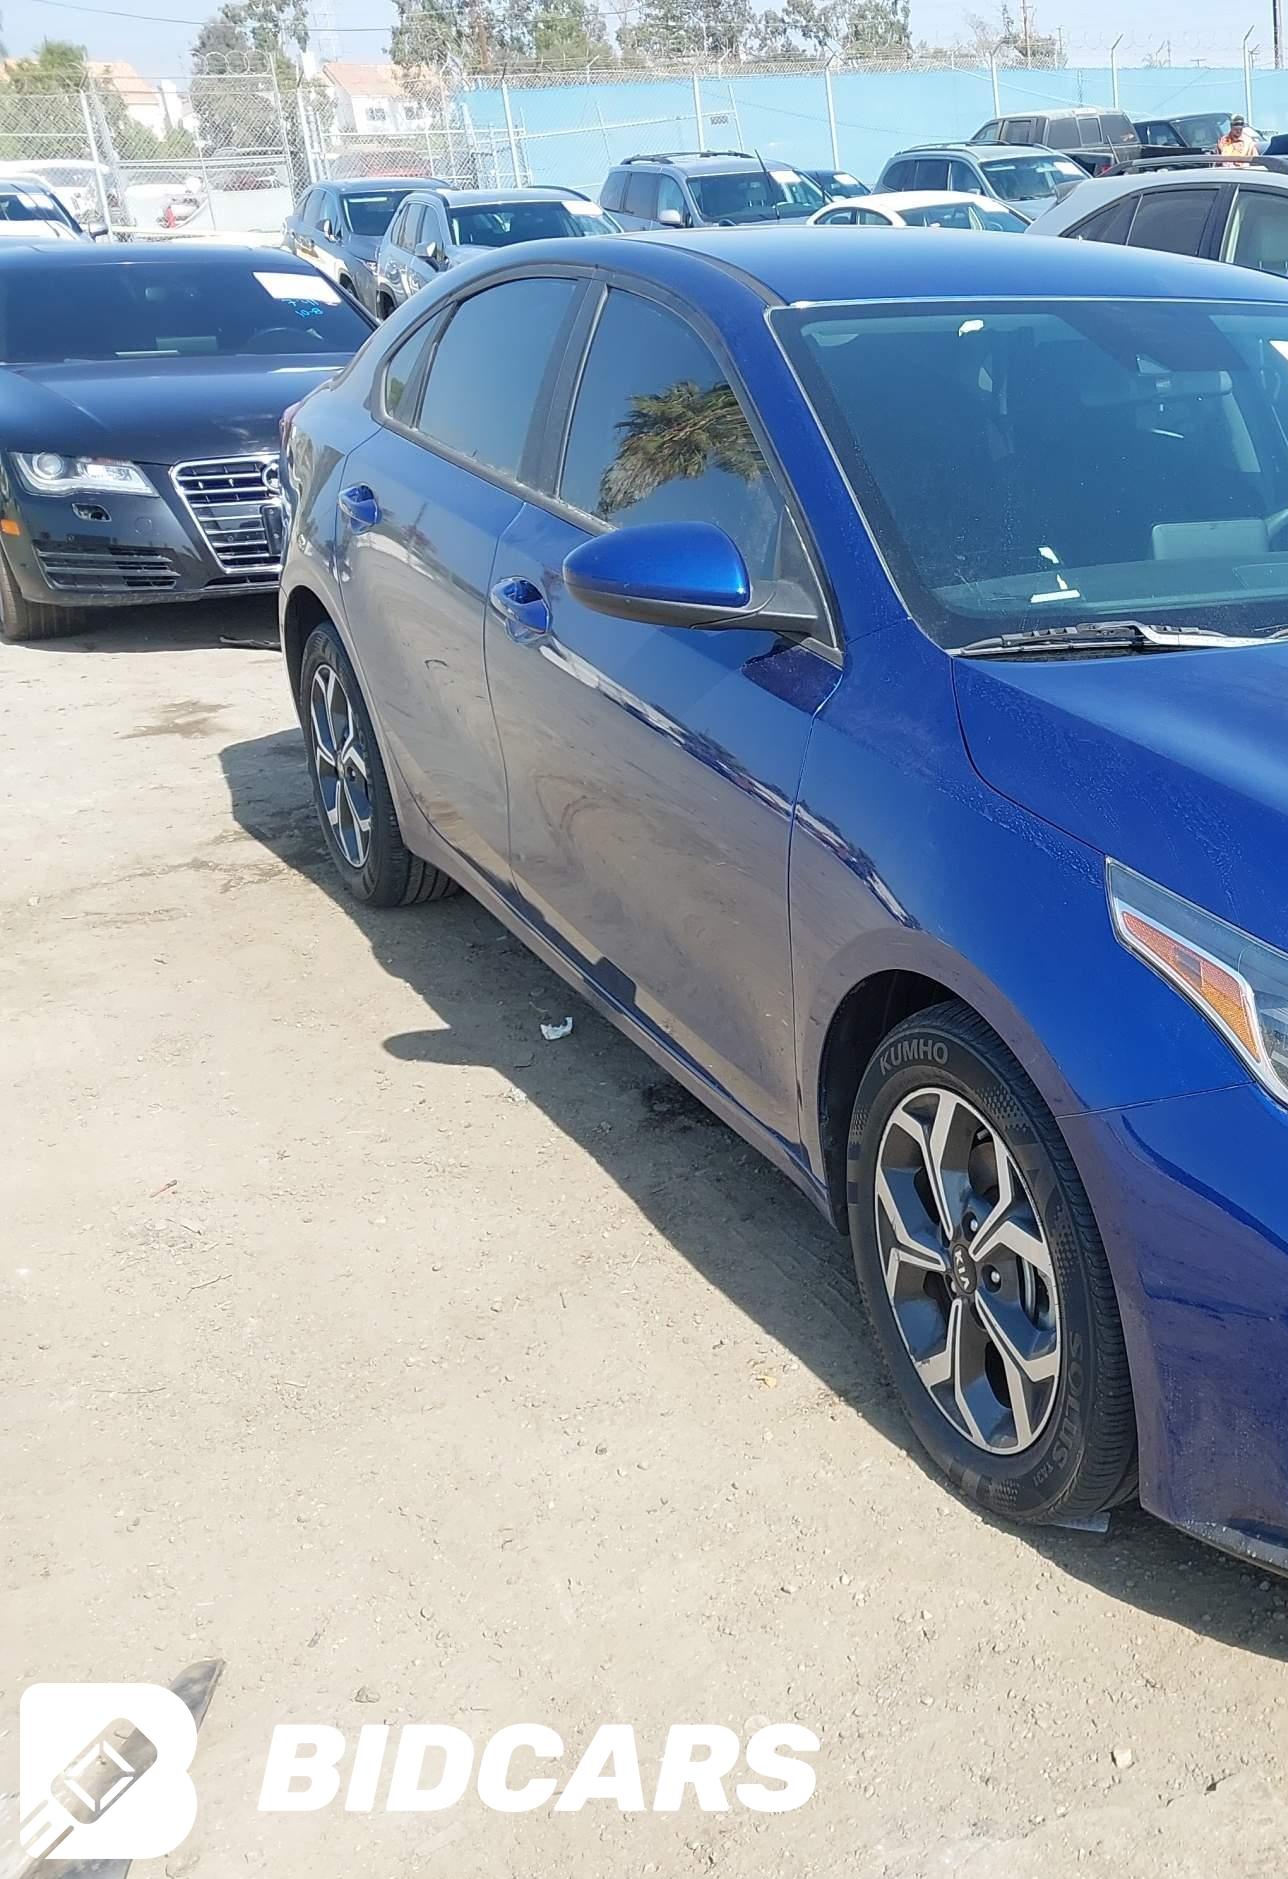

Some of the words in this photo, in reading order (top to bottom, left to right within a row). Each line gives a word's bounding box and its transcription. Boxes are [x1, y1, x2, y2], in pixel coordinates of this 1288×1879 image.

[880, 1038, 949, 1076] KUMHO
[954, 1249, 970, 1291] KIA
[1052, 1330, 1084, 1471] SOLUS
